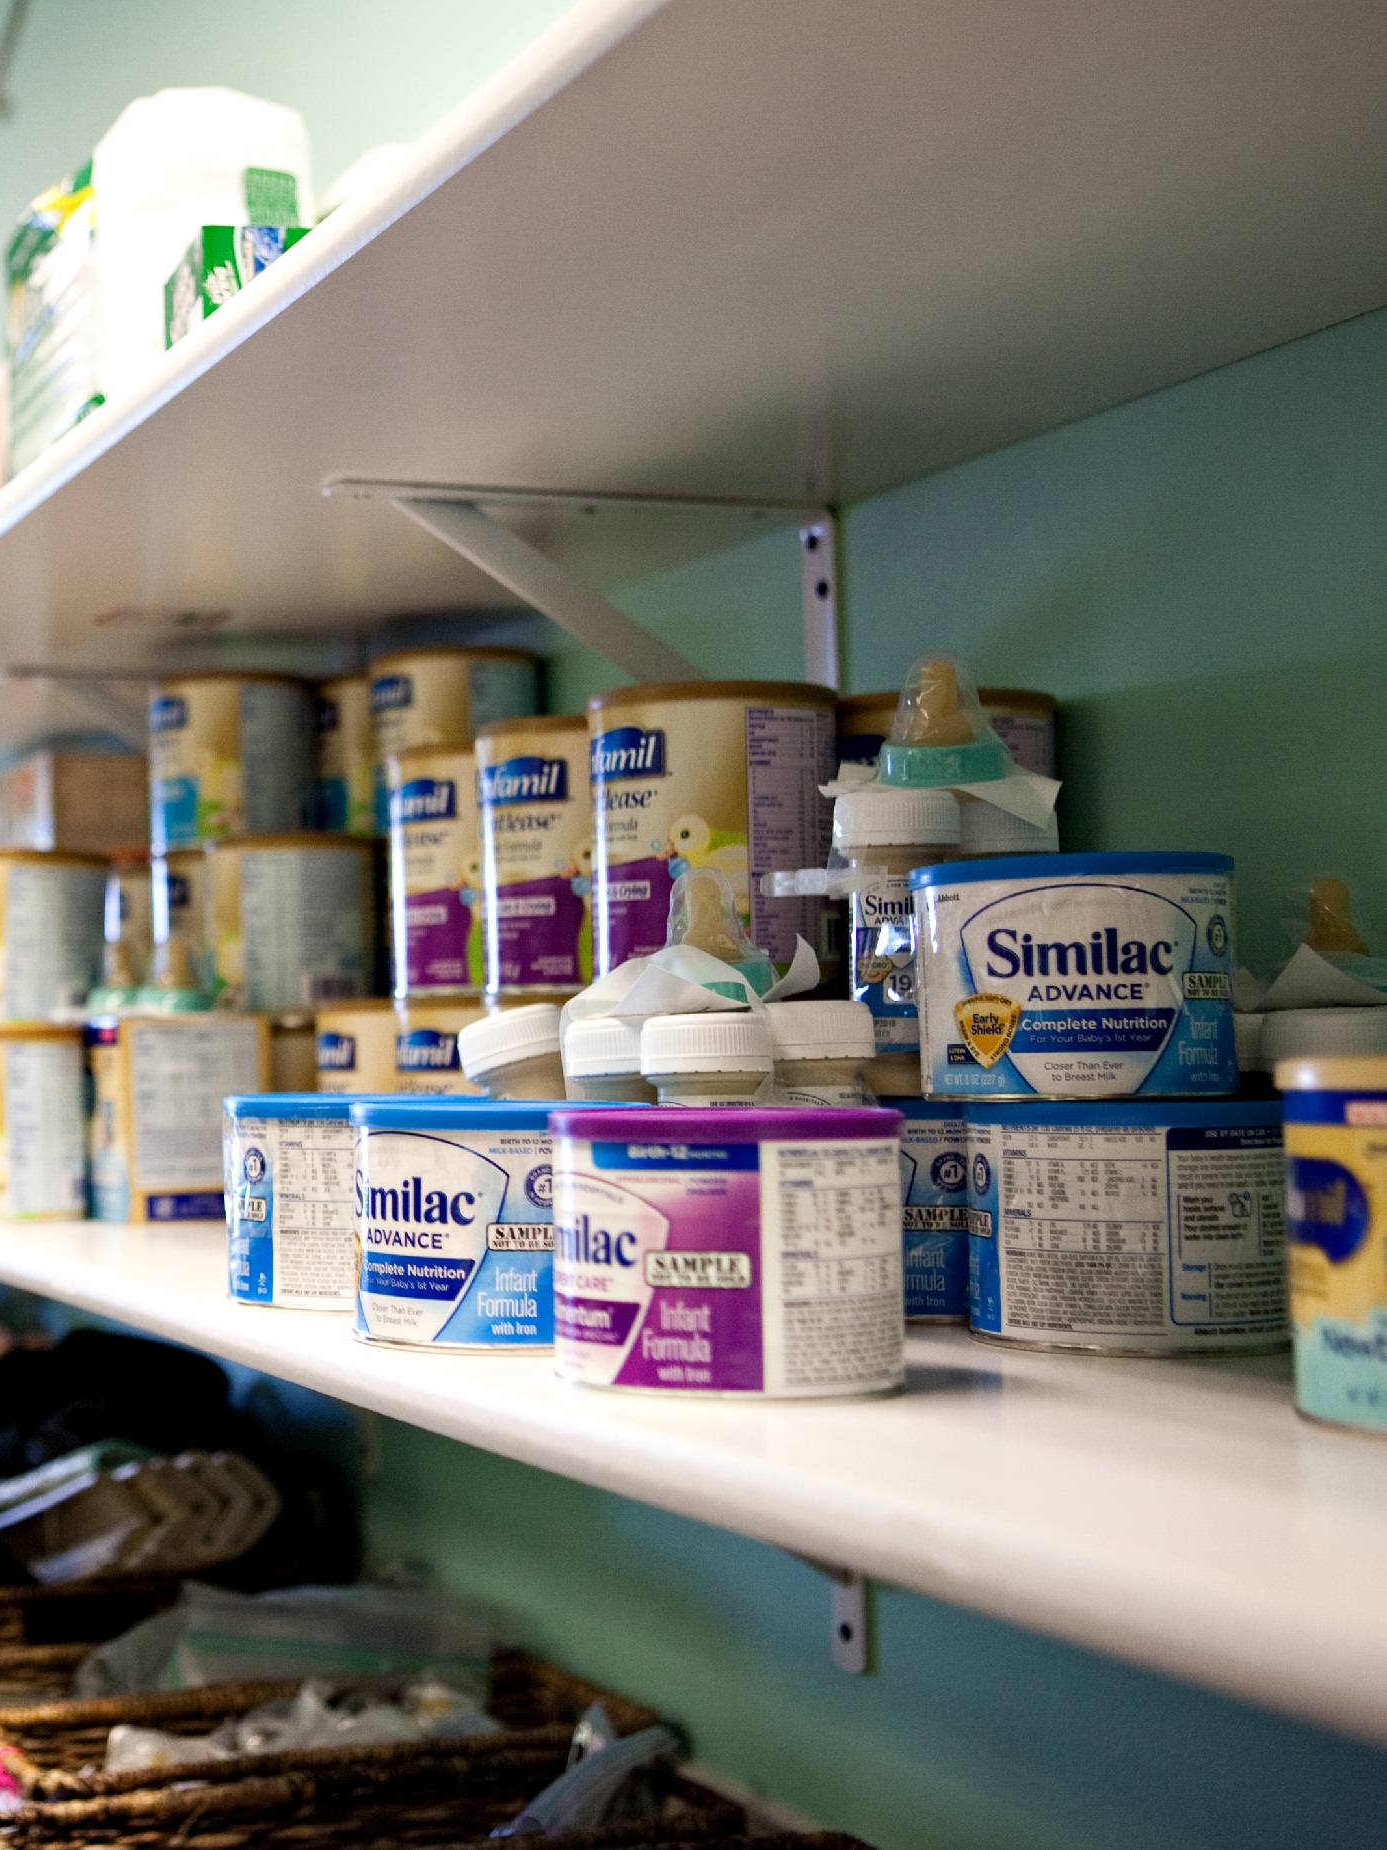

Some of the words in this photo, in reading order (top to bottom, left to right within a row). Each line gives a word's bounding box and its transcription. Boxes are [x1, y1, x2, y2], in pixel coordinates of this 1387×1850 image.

[937, 893, 960, 903] Abbott
[986, 928, 1174, 979] Similac
[1028, 983, 1144, 1002] ADVANCE
[973, 1013, 999, 1025] Early
[1021, 1018, 1097, 1033] Complete
[1102, 1017, 1167, 1030] Nutrition
[971, 1023, 1002, 1035] Shield
[1190, 1015, 1219, 1040] Infant
[1030, 1035, 1046, 1043] For
[1050, 1034, 1074, 1043] Your
[1077, 1034, 1112, 1044] Baby's
[1178, 1040, 1219, 1066] Formula
[1044, 1062, 1073, 1071] Closer
[1077, 1061, 1100, 1070] Than
[1103, 1061, 1123, 1069] Ever
[1052, 1073, 1062, 1081] to
[1064, 1072, 1095, 1082] Breast
[1098, 1071, 1116, 1080] Milk
[279, 1140, 303, 1148] VITAMINS
[904, 1208, 968, 1221] SAMPLE
[367, 1229, 443, 1250] ADVANCE
[492, 1240, 510, 1248] NOT
[514, 1240, 526, 1248] TO
[528, 1240, 541, 1248] BE
[408, 1264, 466, 1280] Nutrition
[654, 1257, 742, 1274] SAMPLE
[391, 1279, 415, 1289] Baby's
[417, 1281, 427, 1290] 1st
[430, 1282, 450, 1291] Year
[496, 1266, 538, 1292] Infant
[477, 1293, 538, 1317] Formula
[926, 1296, 945, 1307] Iron
[390, 1304, 405, 1314] Than
[407, 1305, 423, 1316] Ever
[659, 1300, 711, 1333] Infant
[383, 1315, 403, 1325] Breast
[404, 1316, 417, 1326] Milk
[491, 1322, 515, 1335] with
[517, 1322, 537, 1335] Iron
[642, 1327, 712, 1363] Formula
[656, 1367, 684, 1382] with
